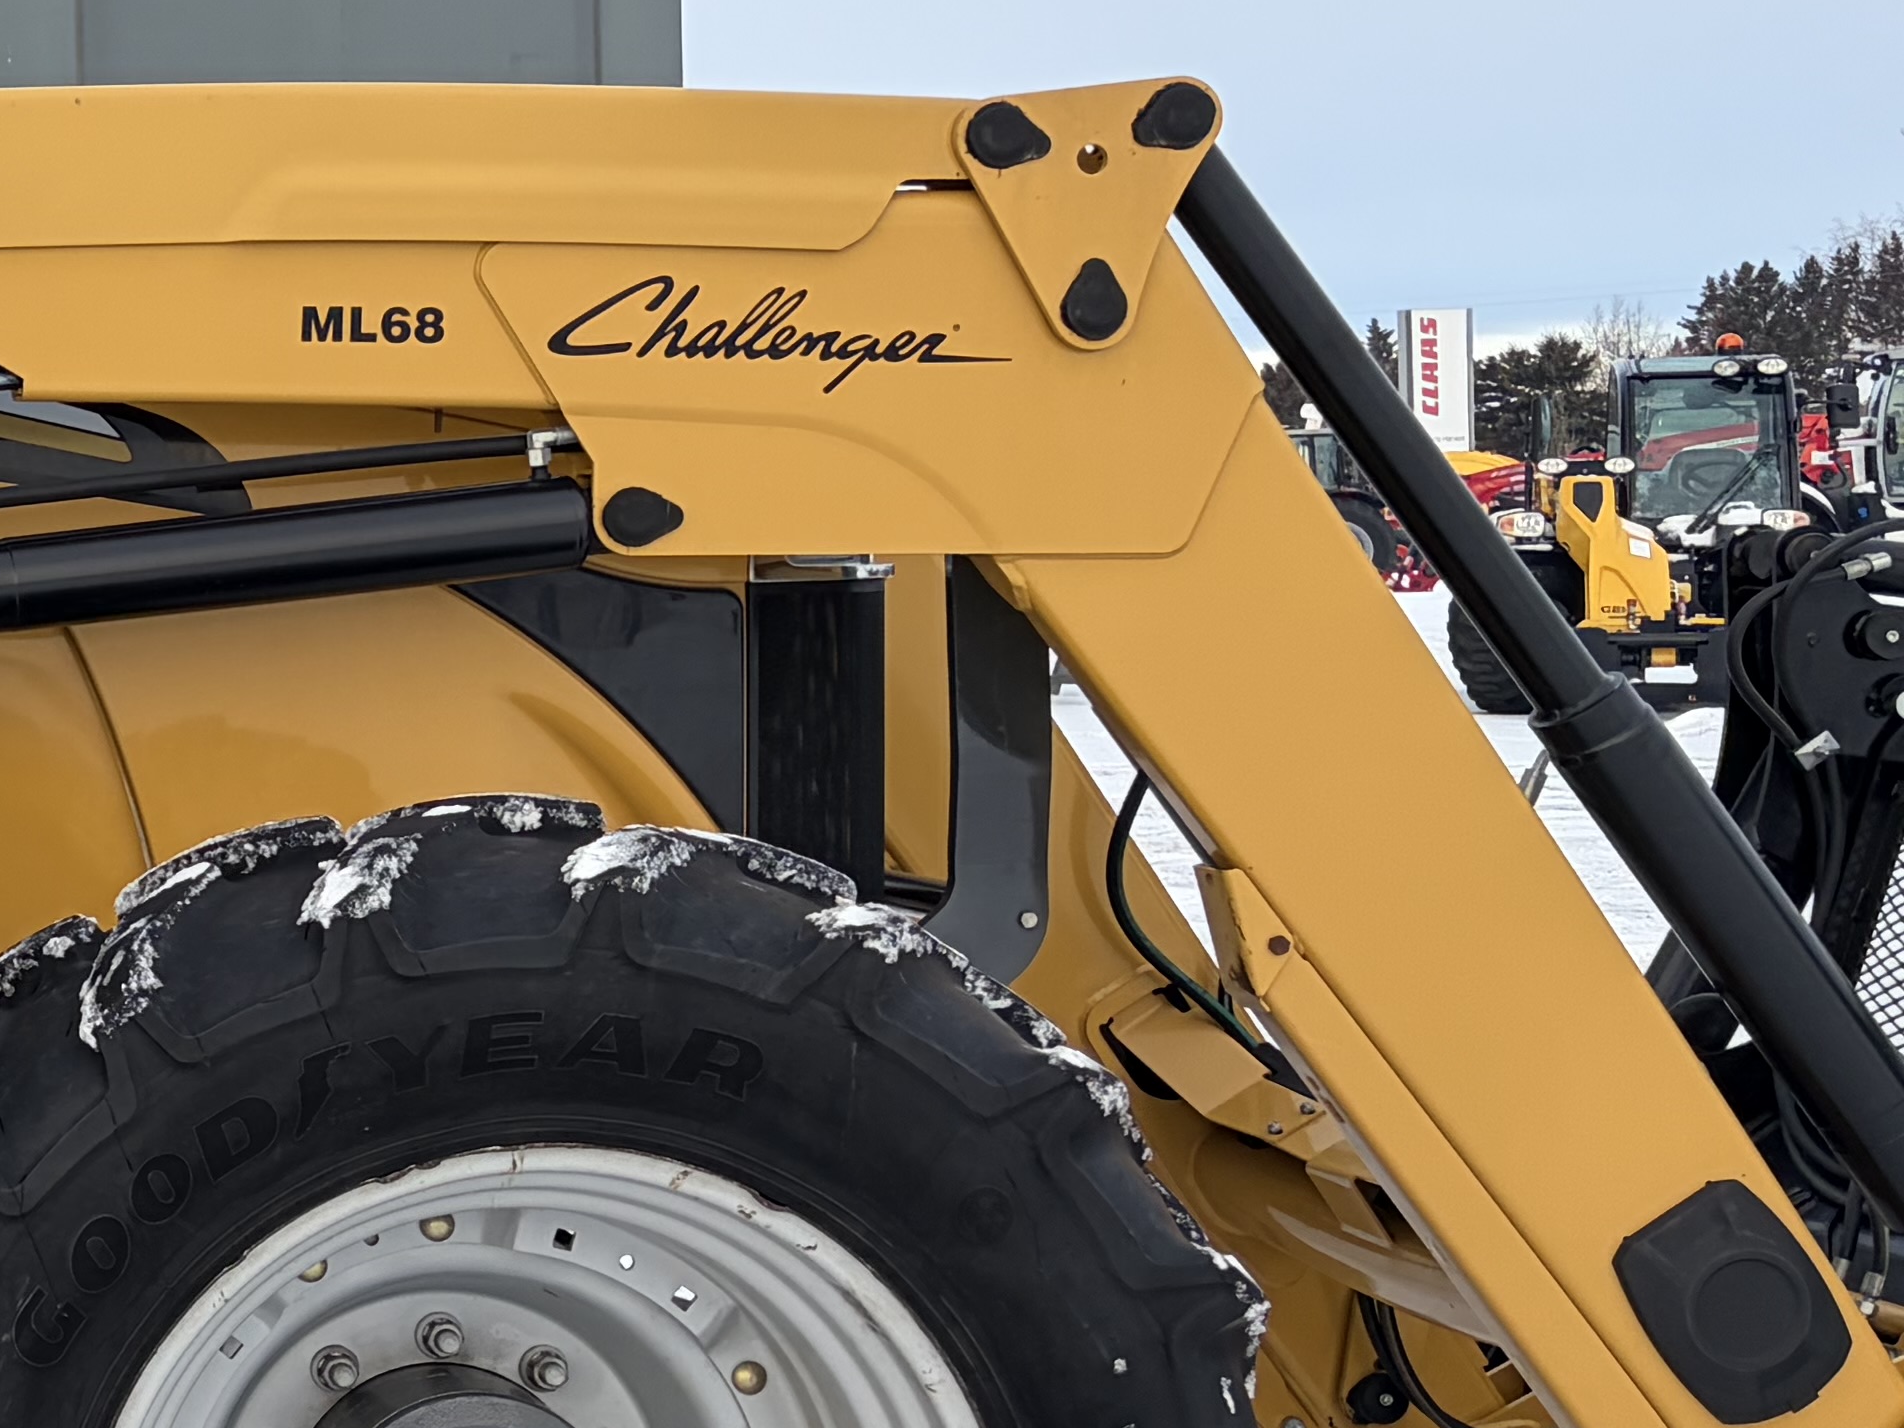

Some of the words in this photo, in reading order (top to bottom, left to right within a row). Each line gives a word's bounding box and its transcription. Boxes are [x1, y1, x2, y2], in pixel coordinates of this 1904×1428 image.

[300, 306, 445, 344] ML68
[547, 274, 1013, 395] Challenger
[1420, 316, 1440, 417] CLAAS
[12, 1008, 766, 1369] GOODYEAR
